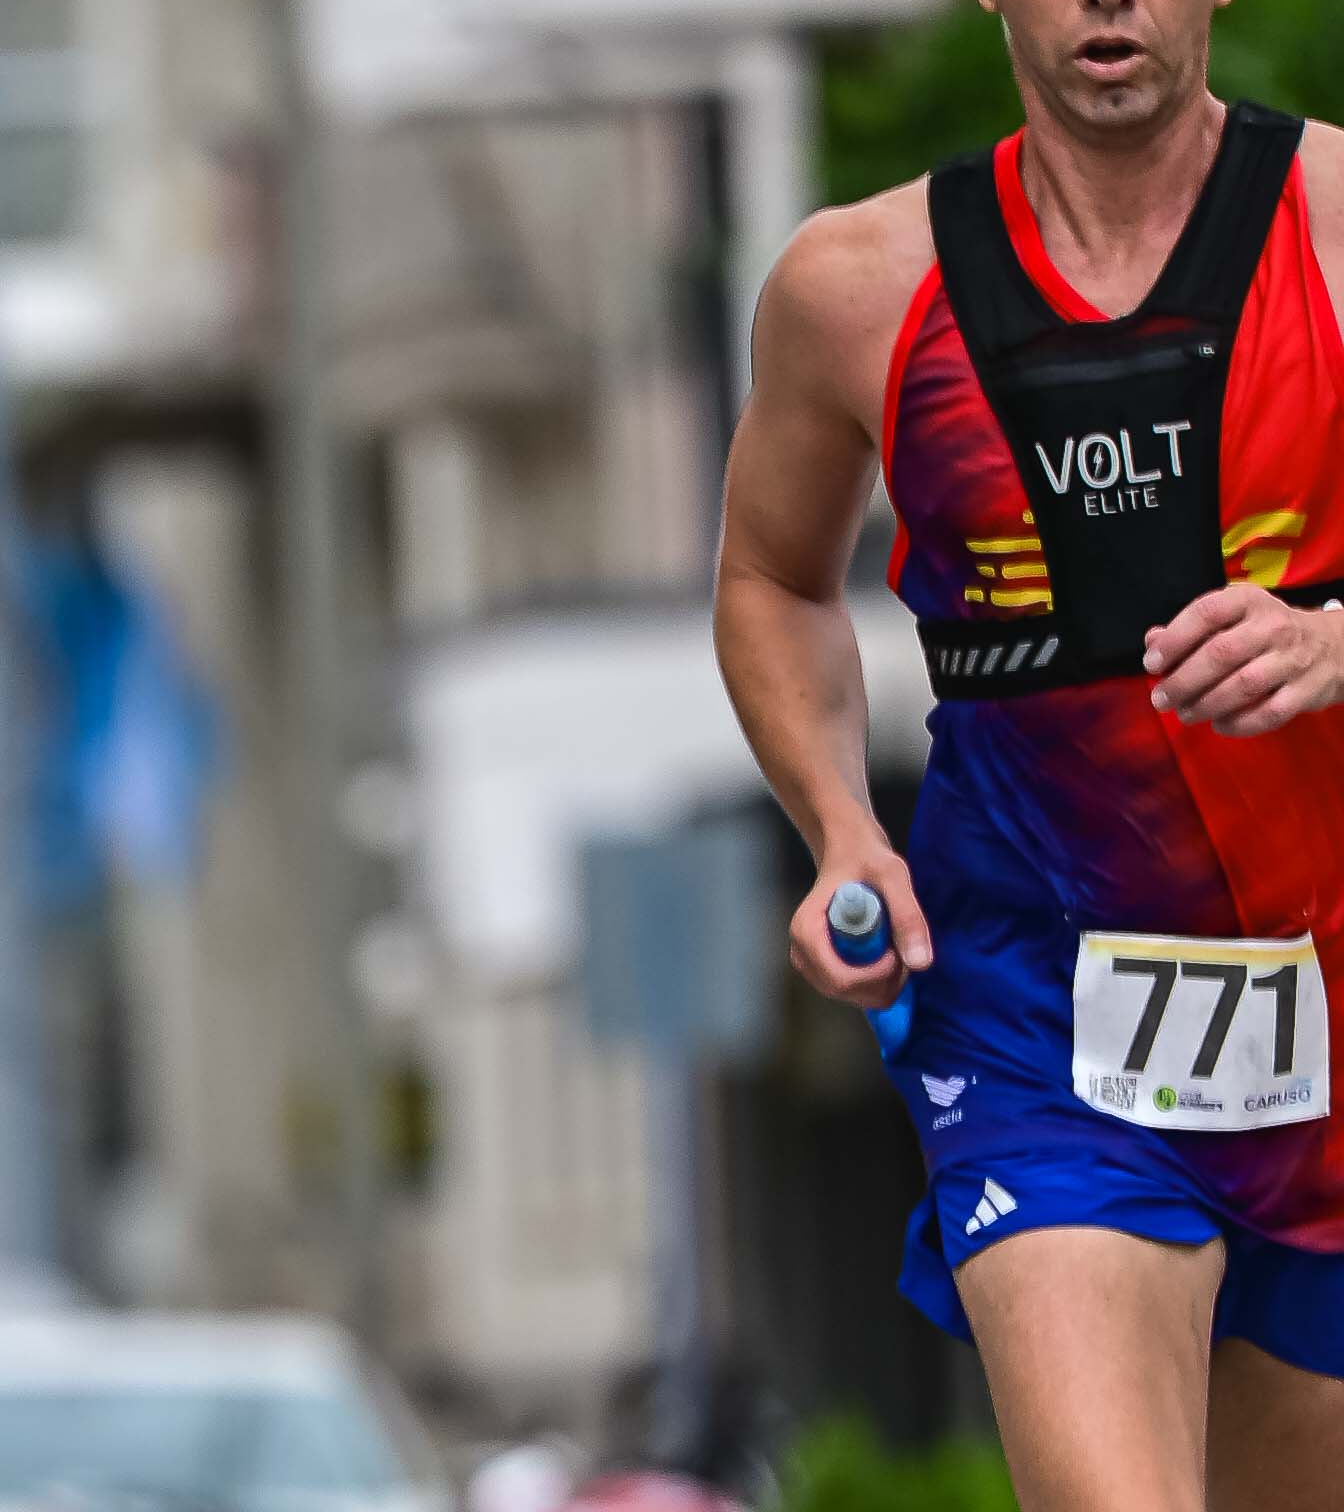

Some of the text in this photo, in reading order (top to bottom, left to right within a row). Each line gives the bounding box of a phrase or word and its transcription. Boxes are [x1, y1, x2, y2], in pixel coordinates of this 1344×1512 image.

[1035, 419, 1192, 495] VOLT
[1084, 486, 1160, 517] ELITE
[1112, 957, 1298, 1079] 771
